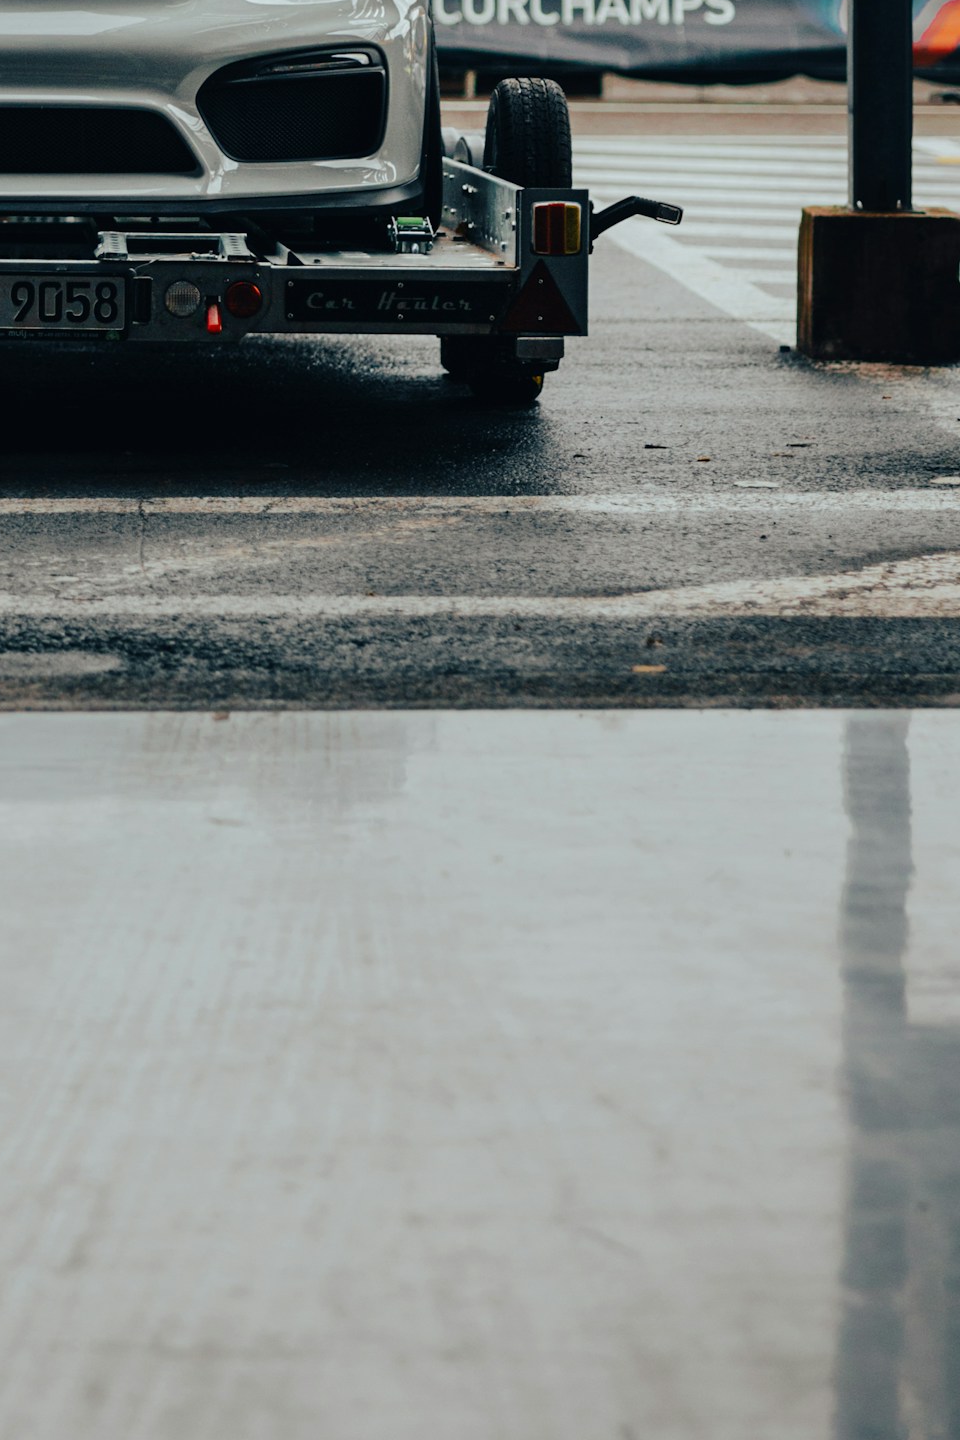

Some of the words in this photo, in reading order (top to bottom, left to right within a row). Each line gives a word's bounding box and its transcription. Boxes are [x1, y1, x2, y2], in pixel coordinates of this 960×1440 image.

[11, 281, 118, 323] 9058
[306, 292, 355, 310] Car
[377, 291, 473, 310] Hauler
